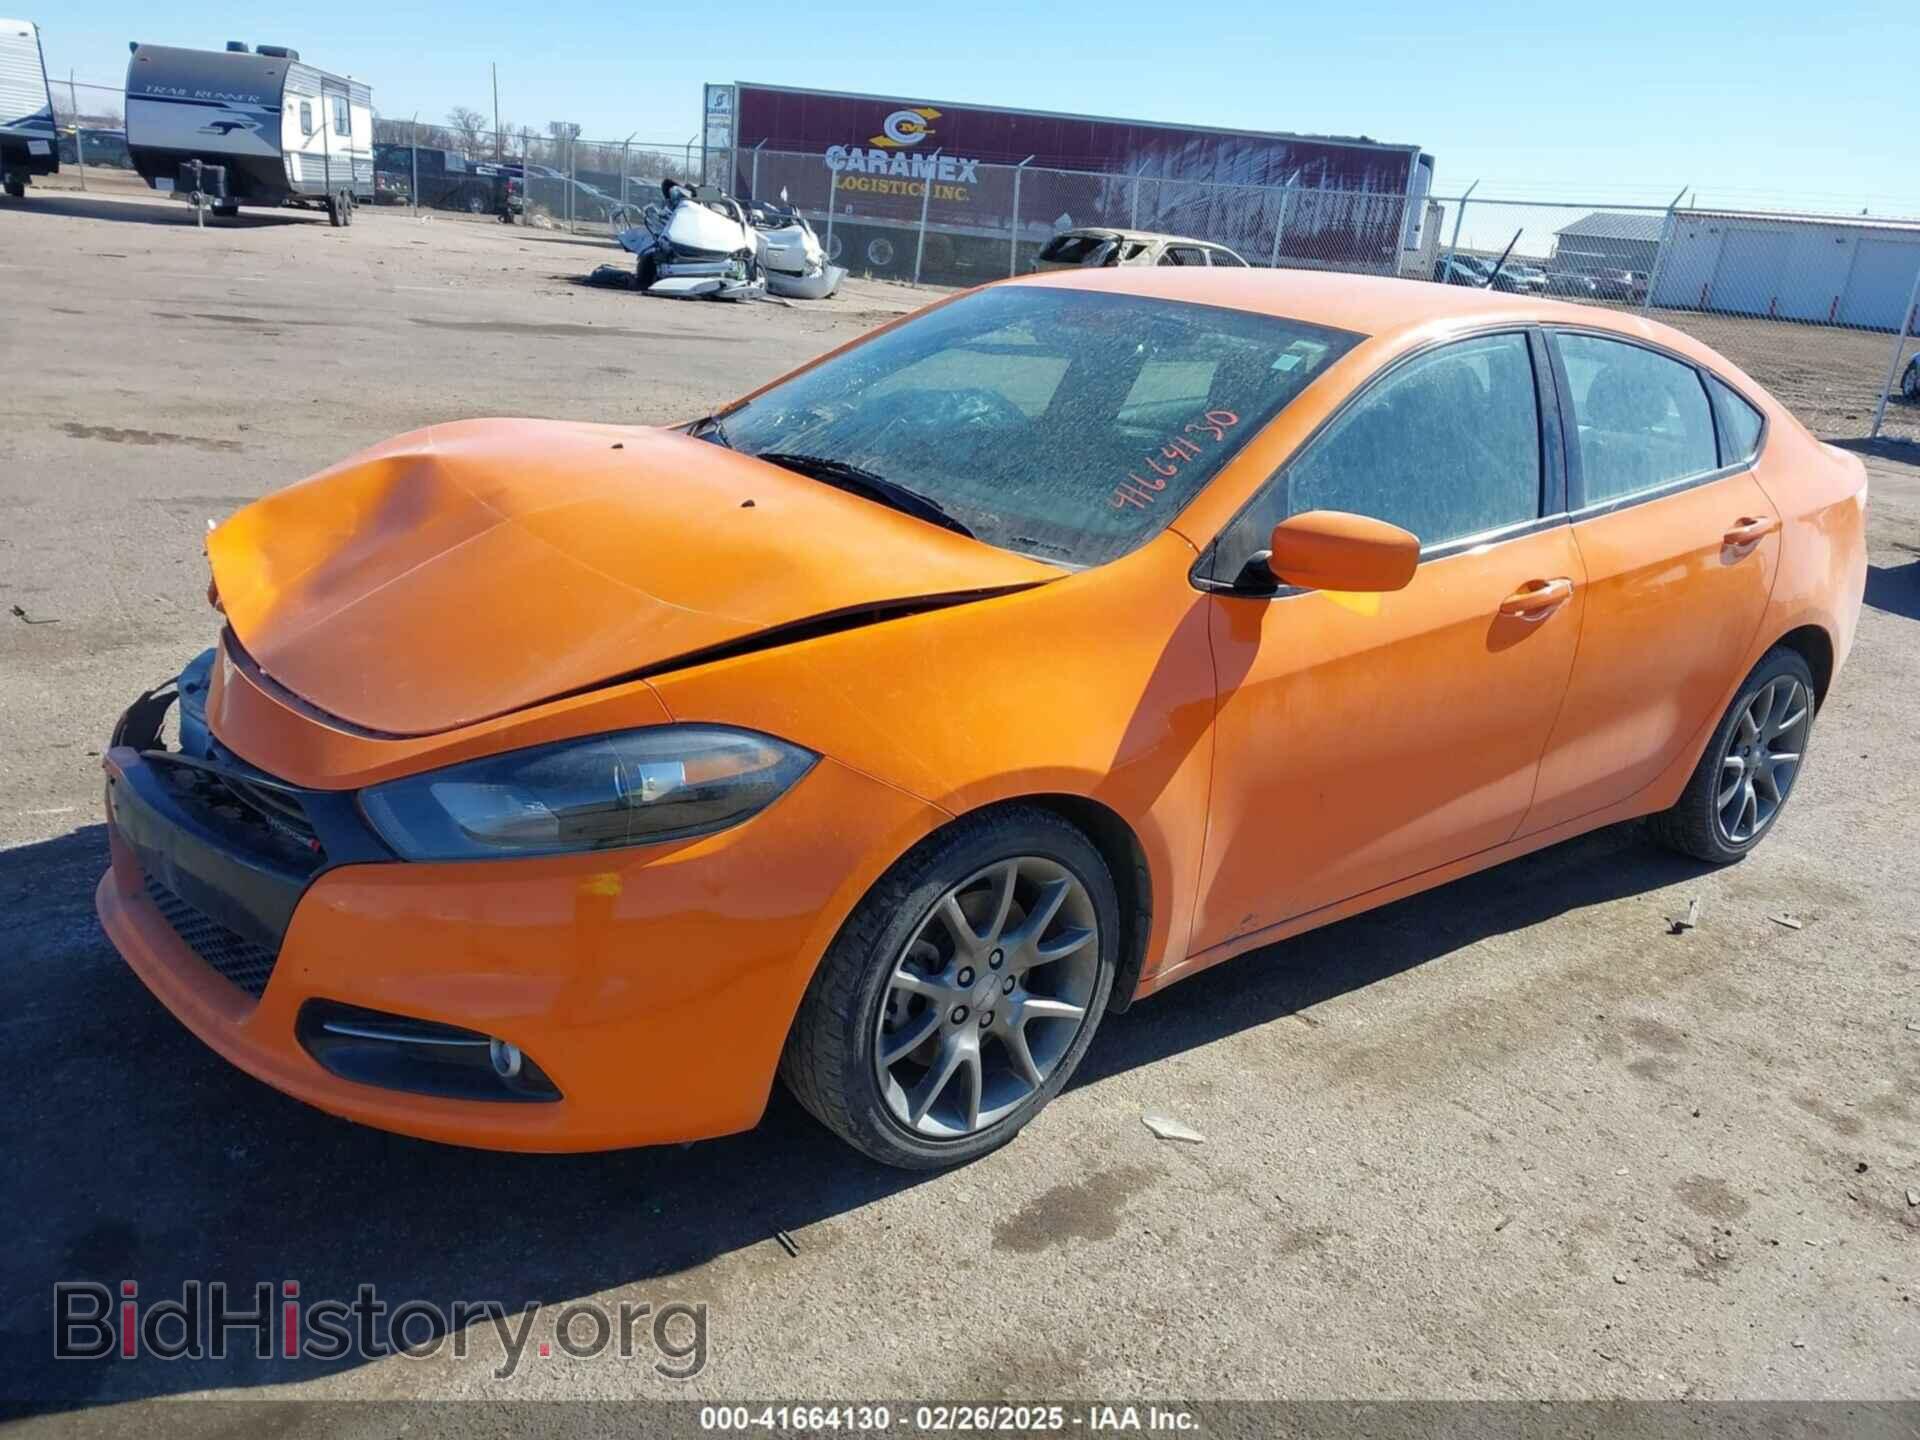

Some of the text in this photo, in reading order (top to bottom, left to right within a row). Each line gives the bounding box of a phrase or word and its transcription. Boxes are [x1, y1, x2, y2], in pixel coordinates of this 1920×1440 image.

[144, 85, 188, 97] TRAIL
[824, 144, 980, 184] CARAMEX
[934, 184, 971, 201] INC.
